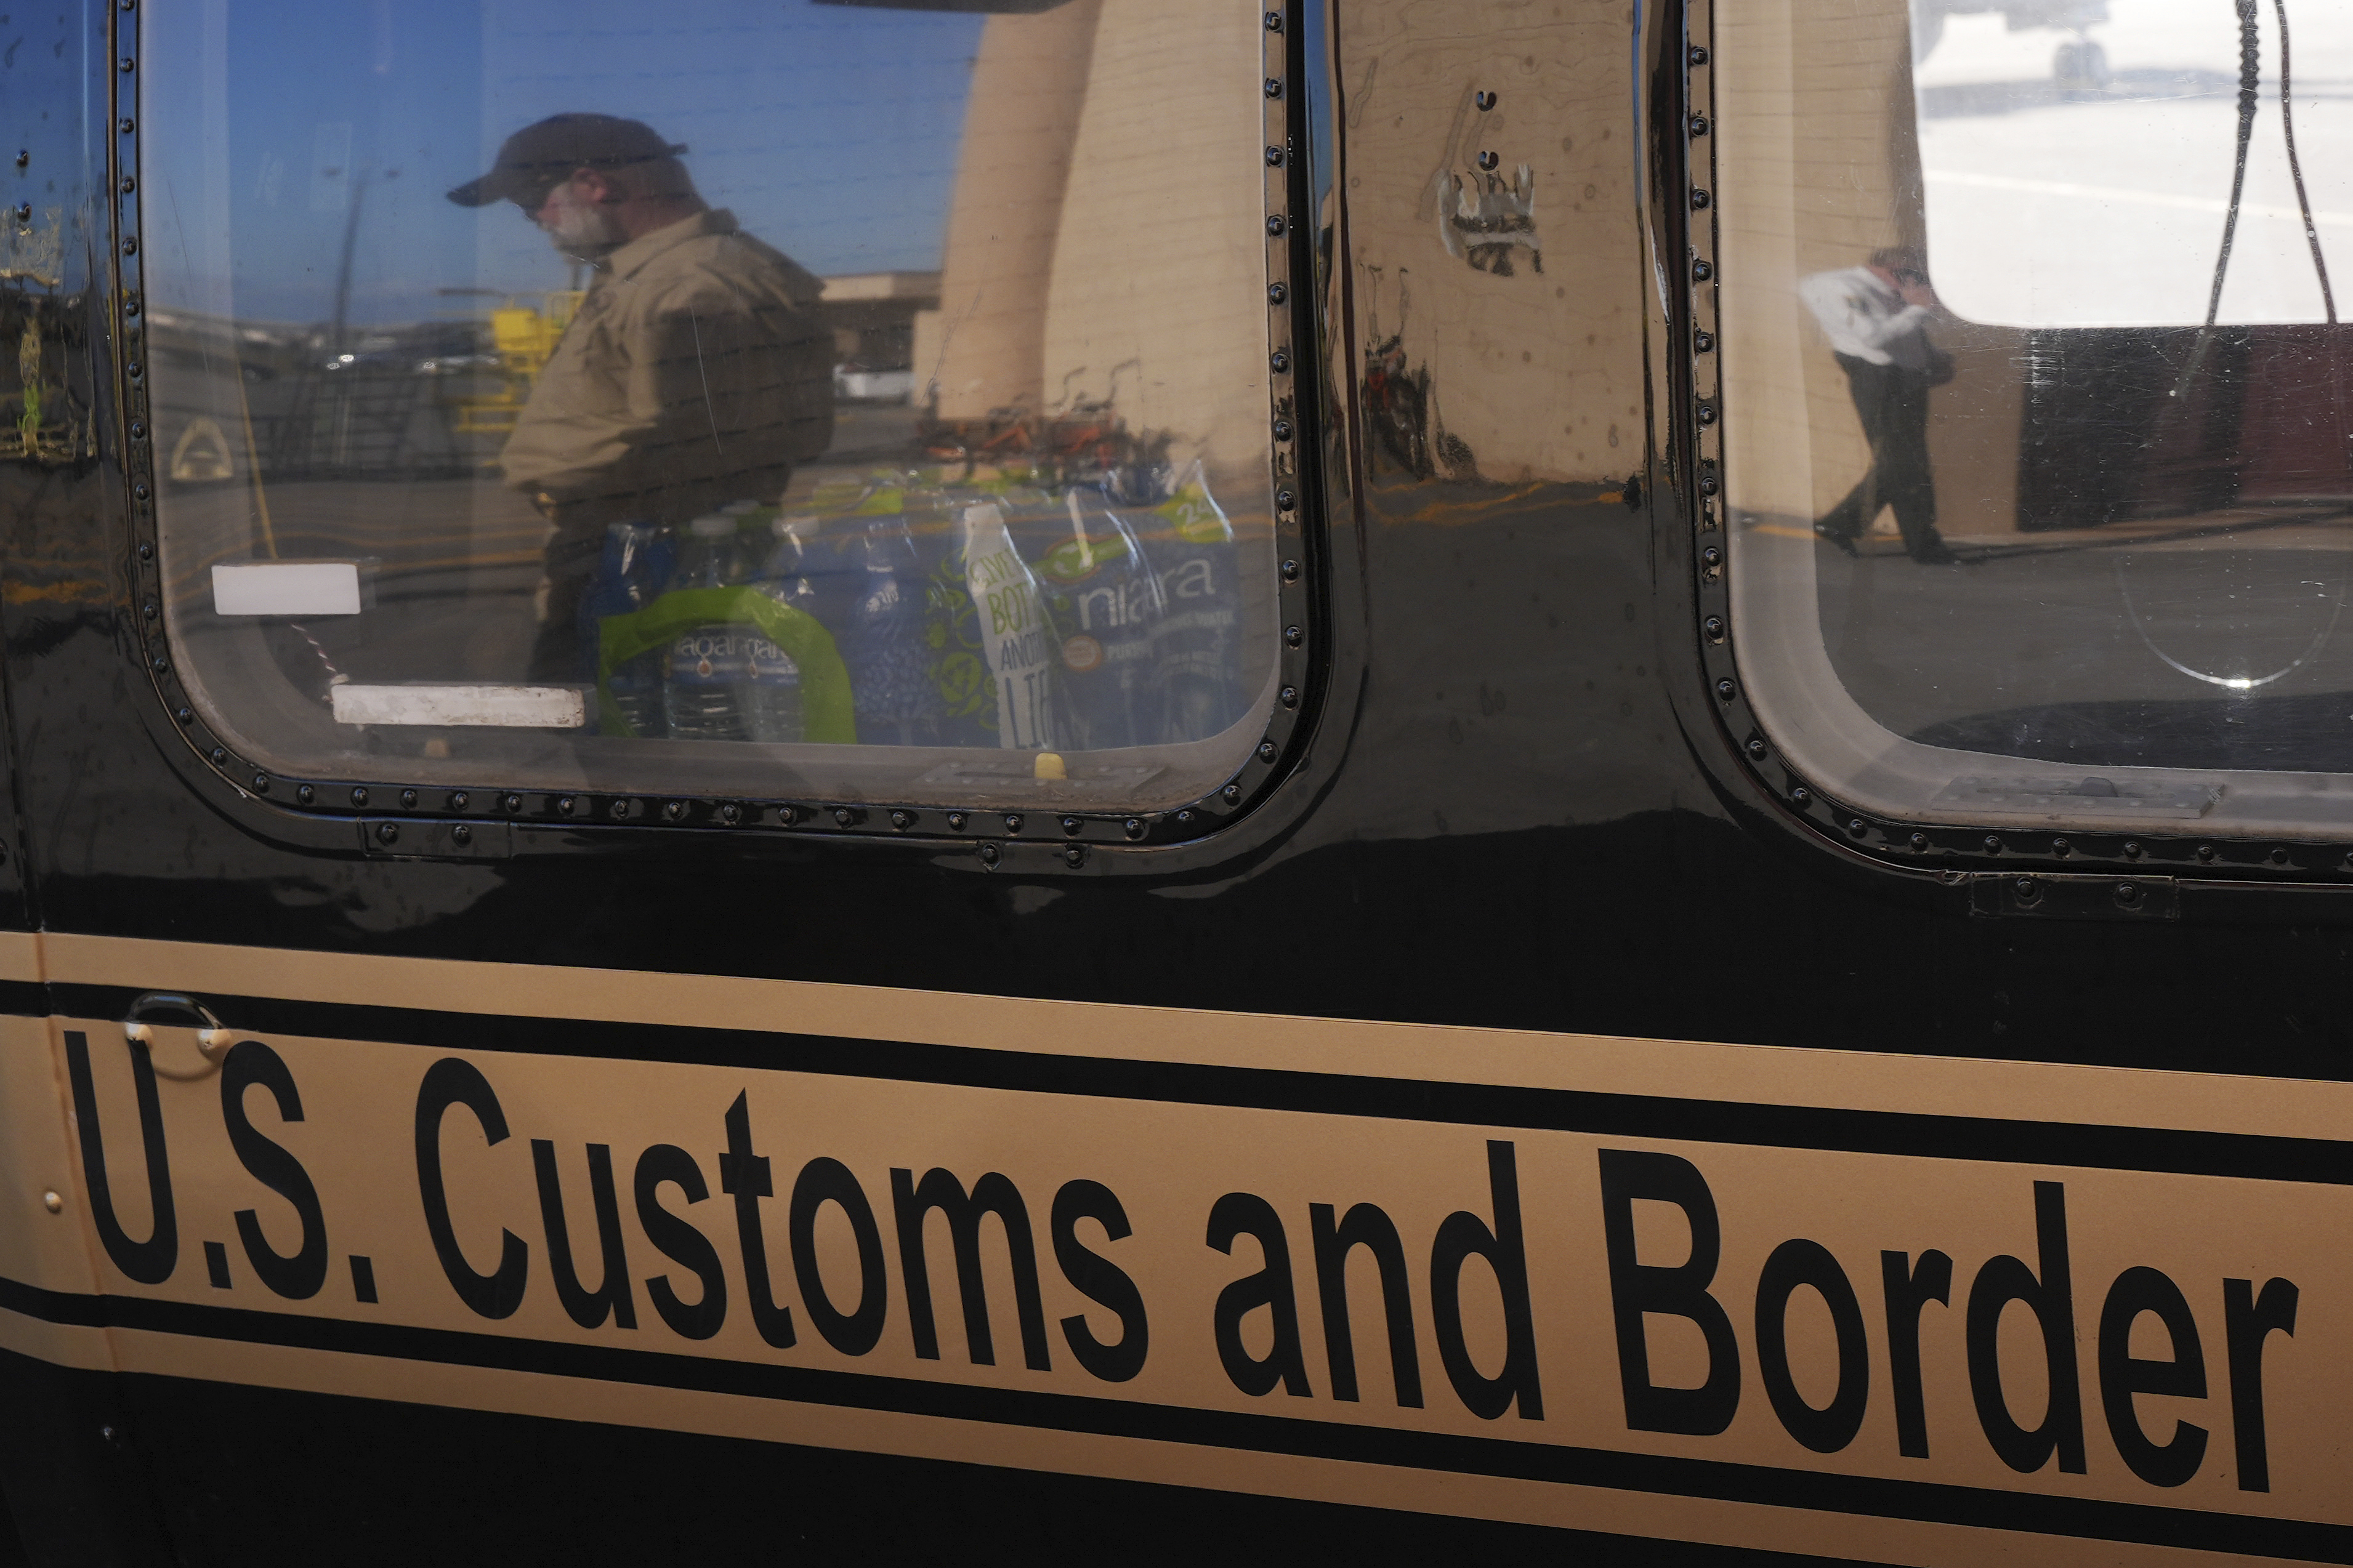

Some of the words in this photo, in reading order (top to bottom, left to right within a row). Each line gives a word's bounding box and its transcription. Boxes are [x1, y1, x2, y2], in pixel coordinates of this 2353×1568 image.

[63, 1030, 379, 1305] U.S.
[414, 1057, 1149, 1383] Customs
[1206, 1140, 1546, 1422] and
[1597, 1148, 2299, 1494] Border
